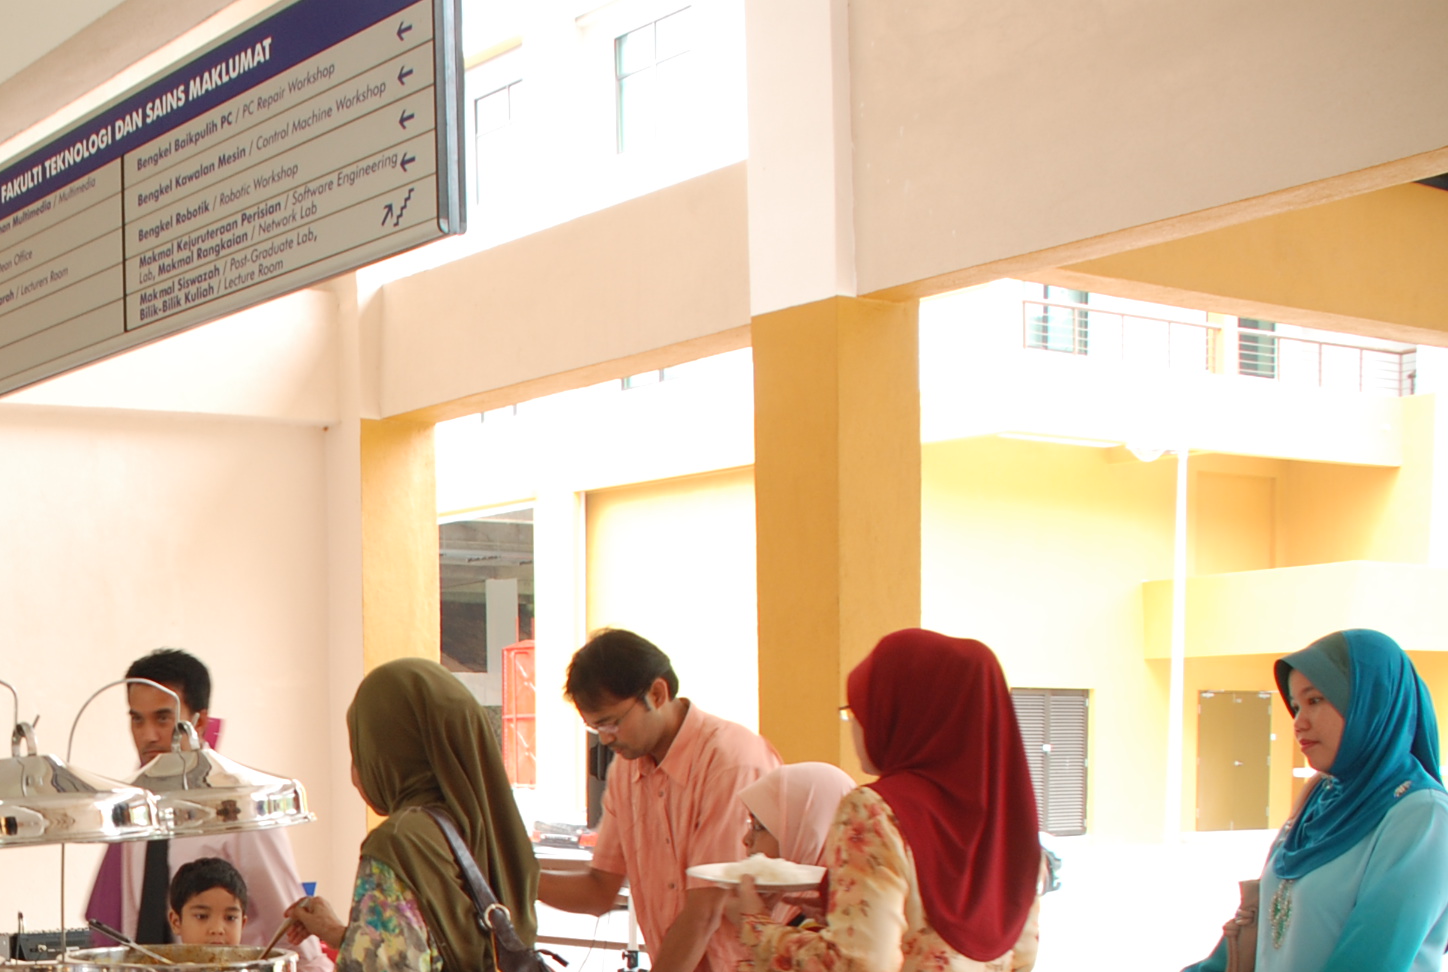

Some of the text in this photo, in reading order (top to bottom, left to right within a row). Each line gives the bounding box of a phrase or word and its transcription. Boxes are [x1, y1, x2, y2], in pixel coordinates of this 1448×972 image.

[1, 37, 272, 203] FAKULTI TEKNOLOGI DAN SAINS MAKLUMAT
[137, 143, 172, 171] Bengkel
[174, 123, 218, 151] Baikpulih
[221, 114, 233, 129] PC
[242, 101, 254, 118] PC
[256, 89, 285, 112] Repair
[288, 63, 335, 95] Workshop
[137, 181, 172, 207] Bengkel
[175, 161, 215, 188] Kawalan
[218, 148, 246, 169] Mesin
[256, 127, 289, 151] Control
[291, 106, 333, 133] Machine
[336, 81, 386, 111] Workshop
[12, 200, 51, 228] Multimedia
[138, 216, 173, 242] Bengkel
[176, 203, 210, 224] Robotik
[219, 182, 251, 205] Robotic
[253, 163, 298, 190] Workshop
[139, 244, 174, 269] Makmal
[177, 221, 238, 254] Kejuruteraan
[241, 201, 281, 225] Perisian
[292, 180, 333, 204] Software
[337, 153, 398, 186] Engineering
[14, 249, 33, 268] Office
[139, 268, 155, 285] Lab,
[158, 252, 194, 277] Makmal
[197, 232, 248, 260] Rangkaian
[258, 212, 297, 236] Network
[300, 202, 317, 221] Lab
[140, 280, 175, 306] Makmal
[177, 265, 220, 292] Siswazah
[230, 233, 294, 271] Post-Graduate
[297, 228, 318, 244] Lab,
[140, 295, 181, 321] Bilik-Bilik
[184, 283, 214, 305] Kuliah
[224, 267, 255, 290] Lecture
[258, 258, 283, 277] Room
